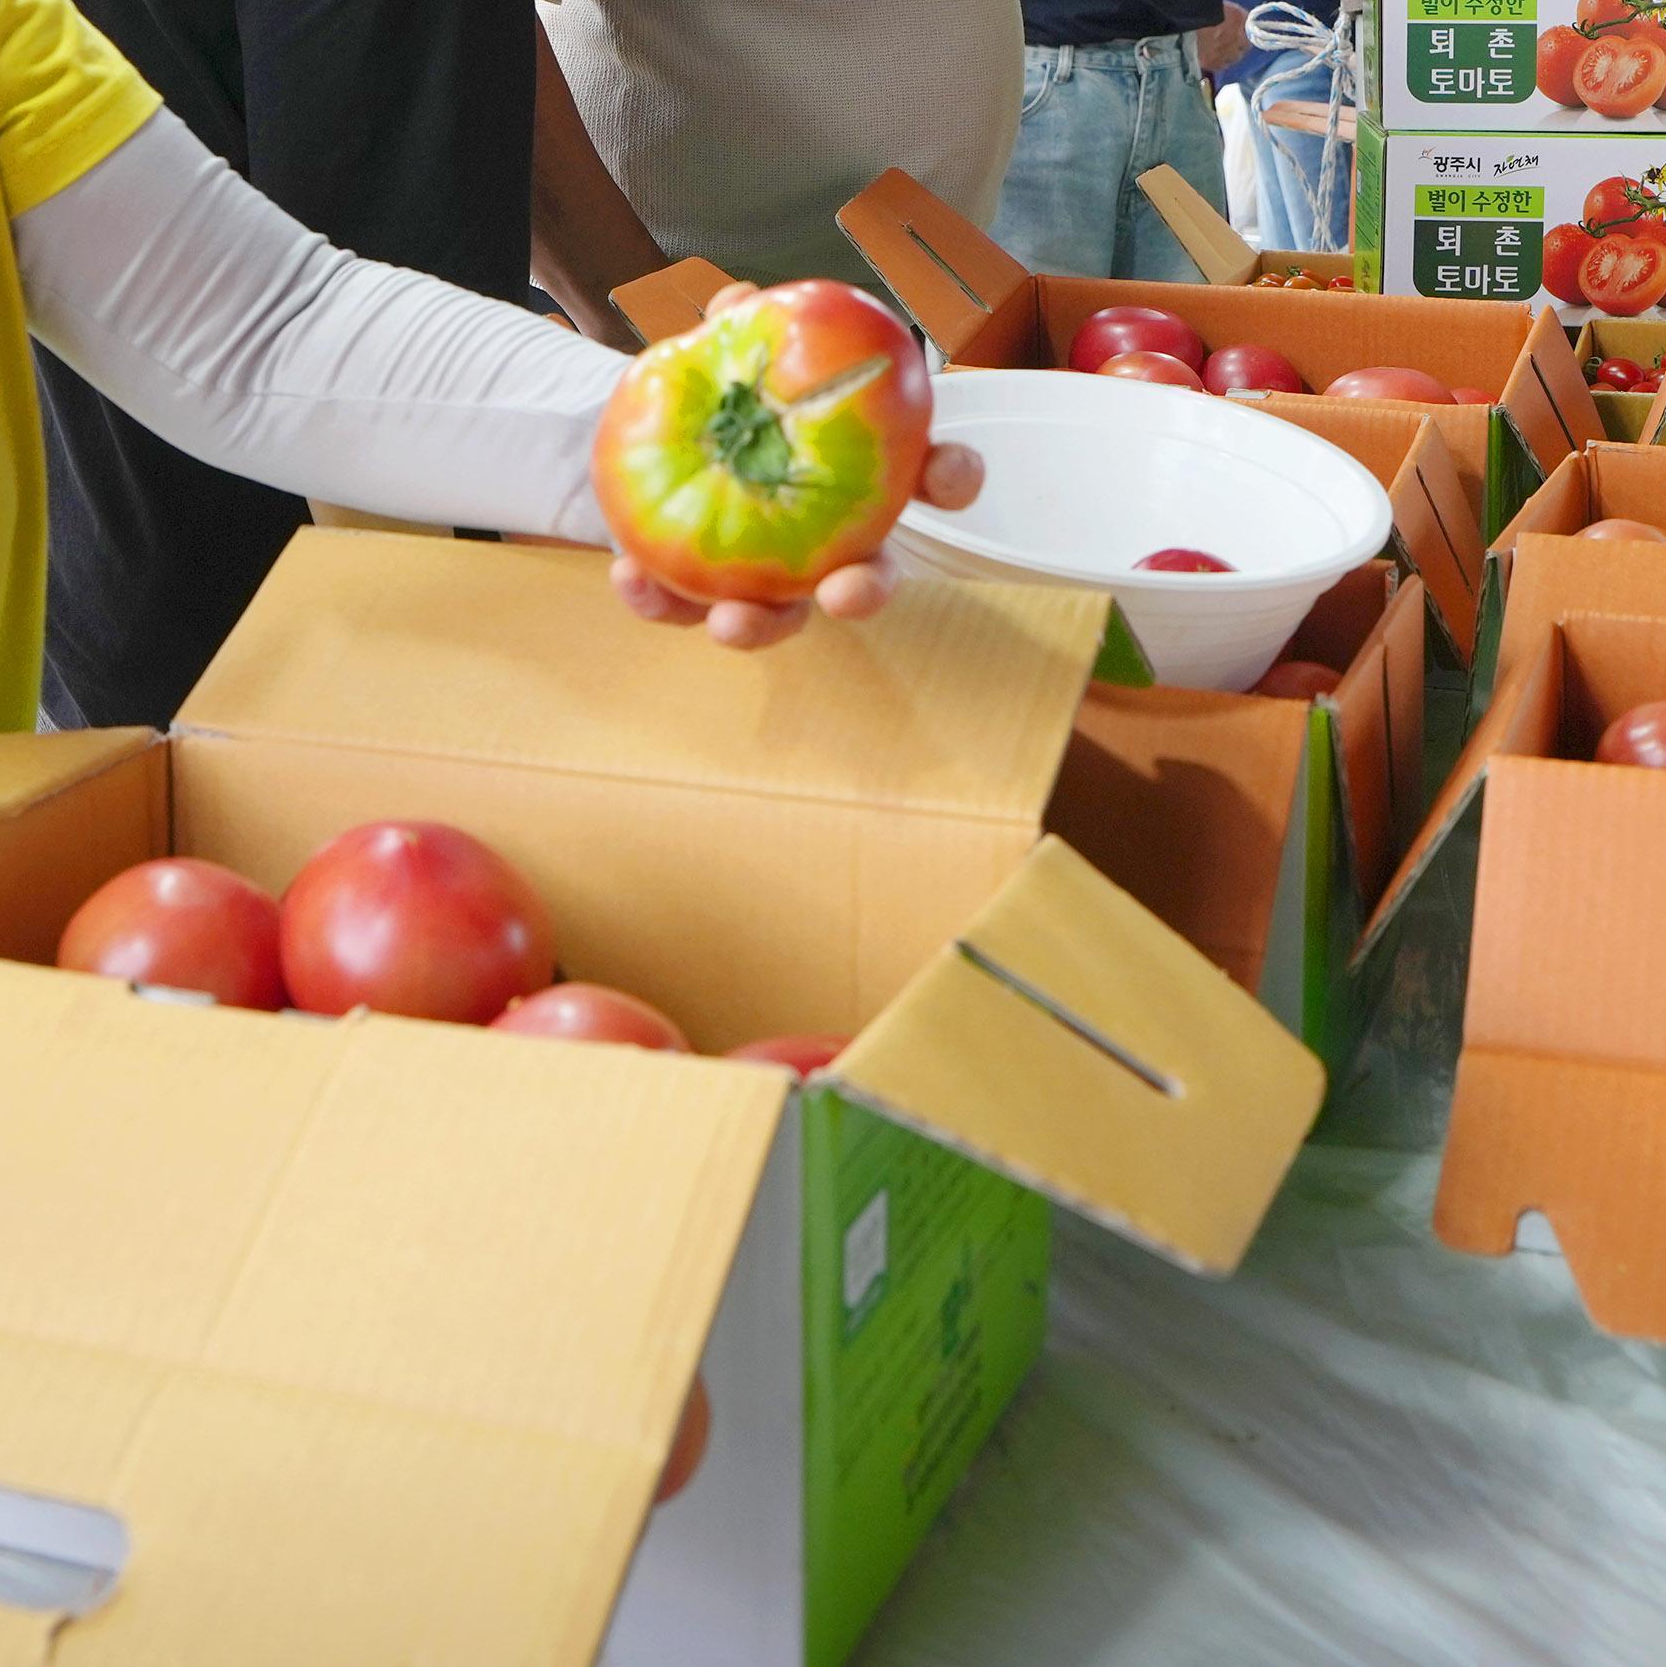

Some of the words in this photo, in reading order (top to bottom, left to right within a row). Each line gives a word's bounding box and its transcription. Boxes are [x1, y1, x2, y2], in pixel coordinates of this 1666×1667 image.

[1428, 67, 1515, 99] 토마토
[1433, 156, 1481, 173] 광주시
[1428, 189, 1467, 213] 벌이
[1472, 190, 1532, 213] 수정한
[1435, 264, 1520, 296] 토마토
